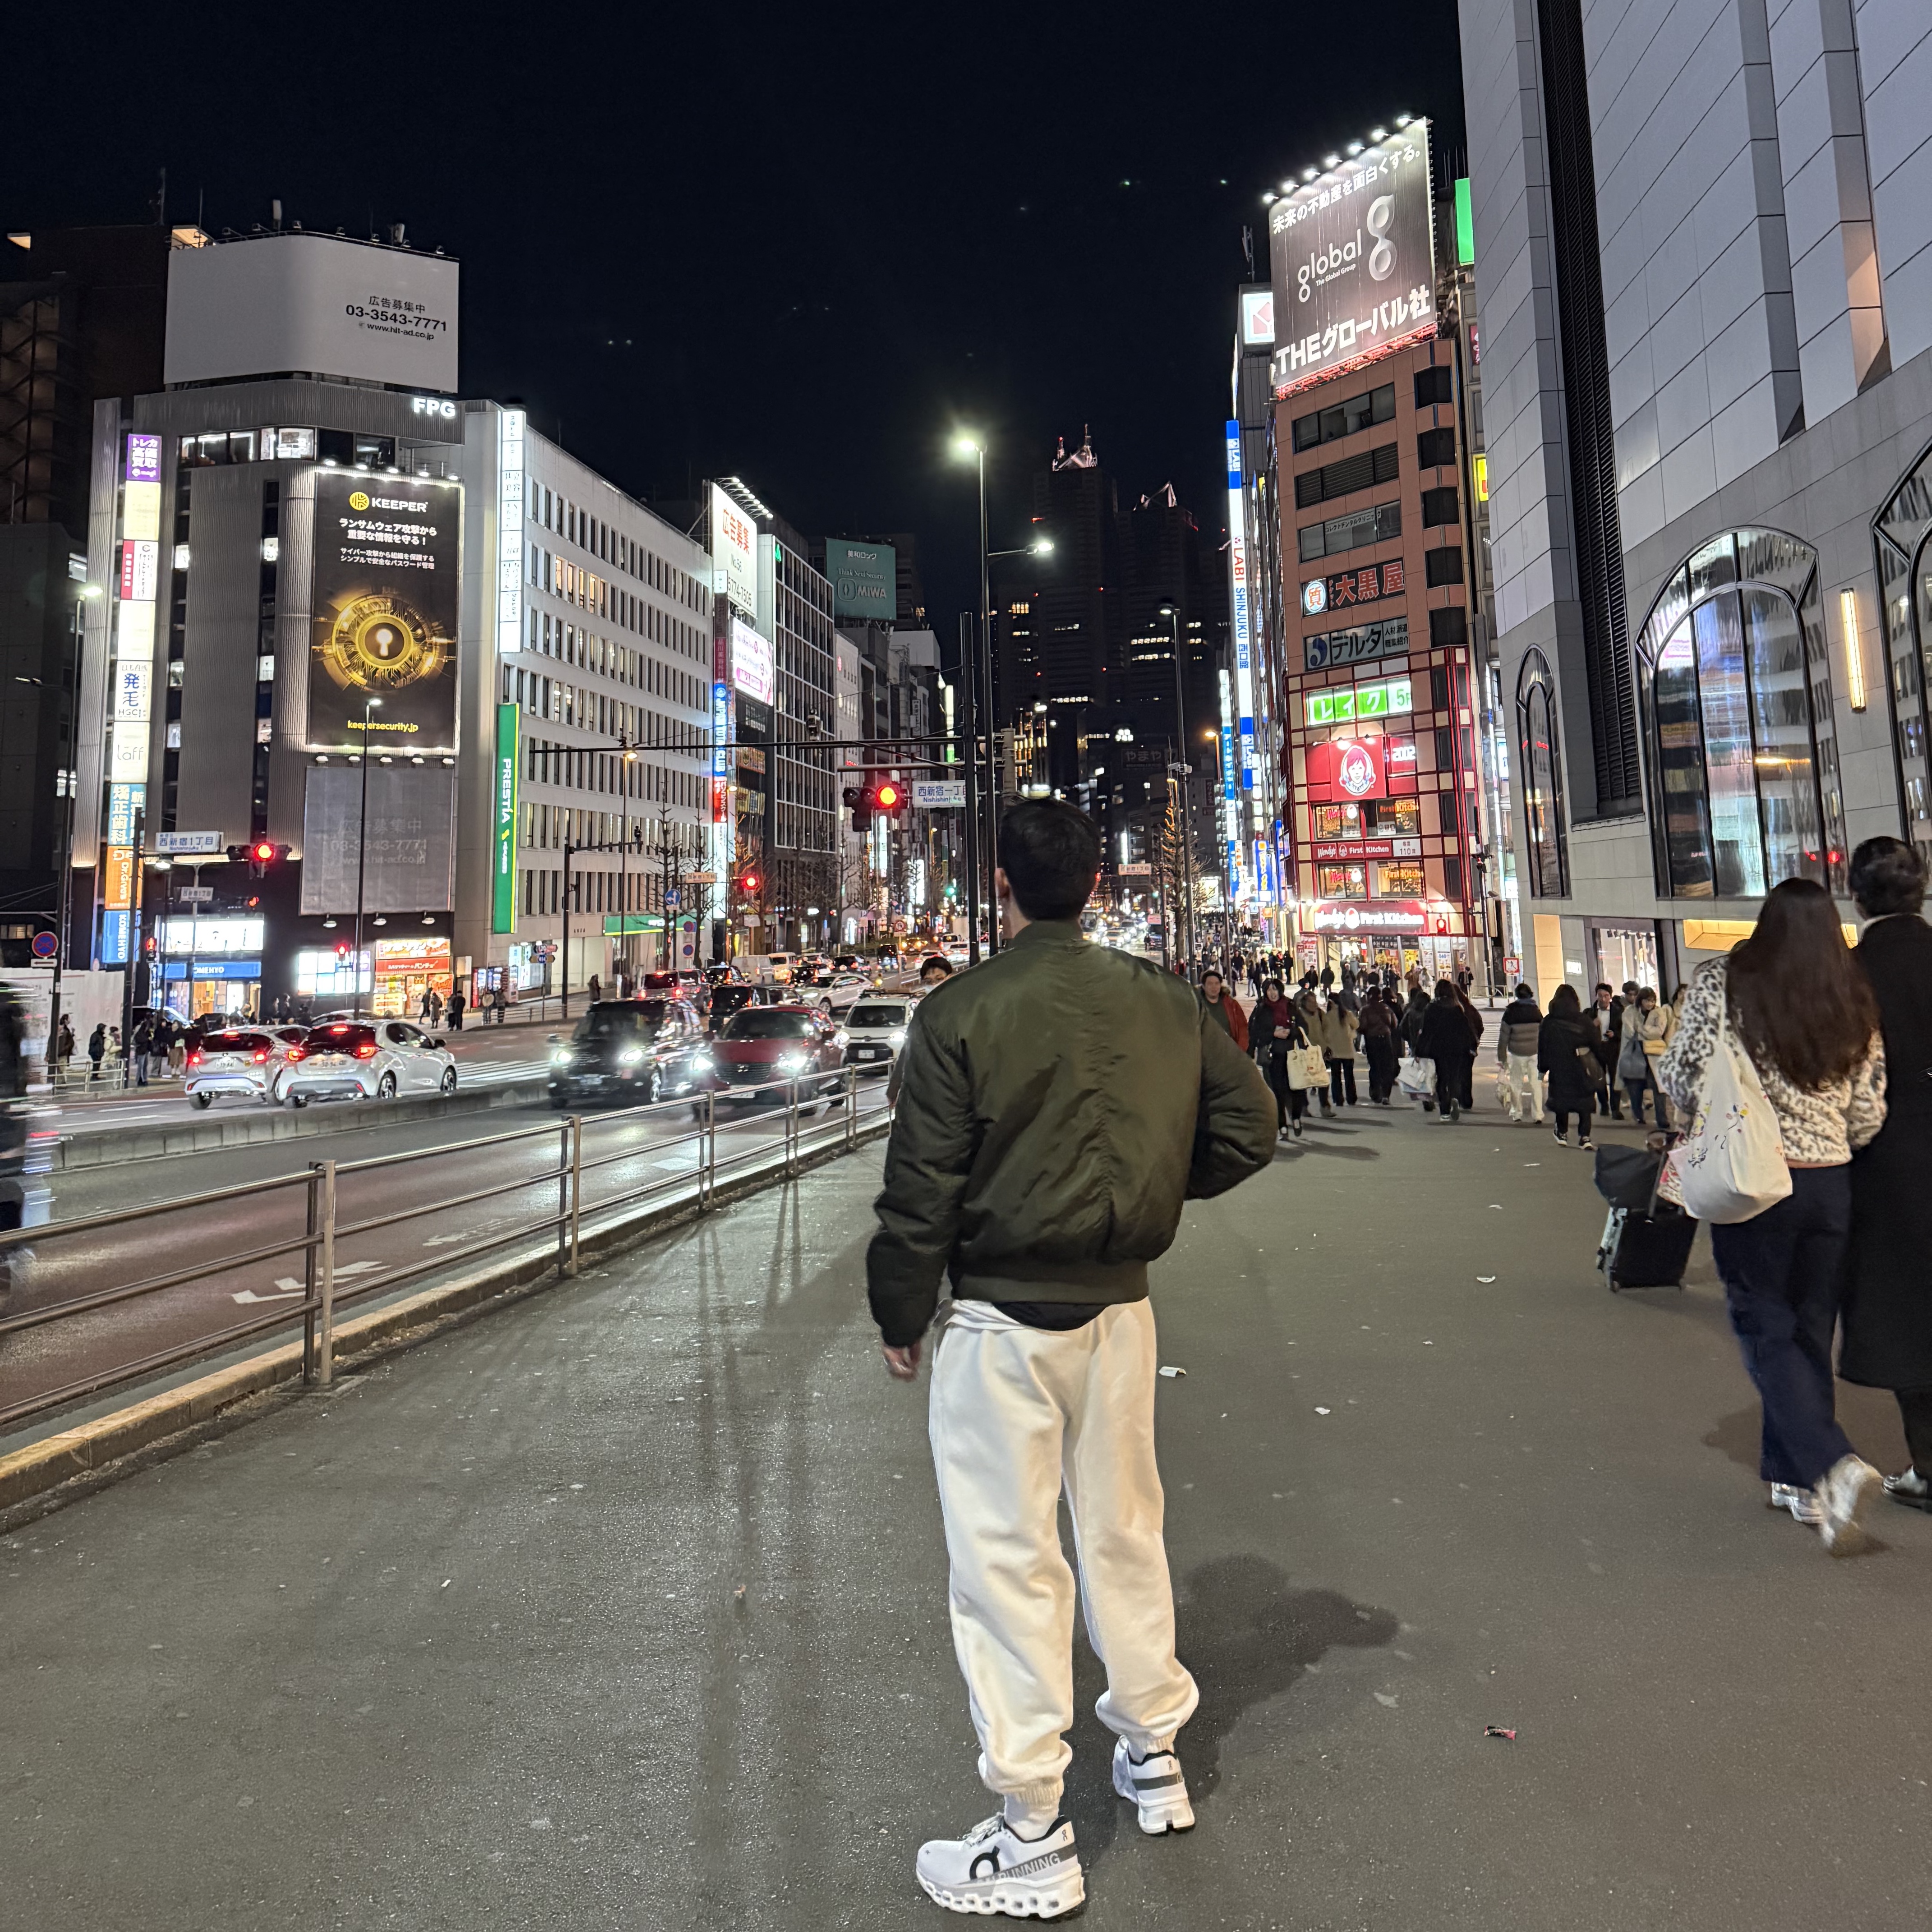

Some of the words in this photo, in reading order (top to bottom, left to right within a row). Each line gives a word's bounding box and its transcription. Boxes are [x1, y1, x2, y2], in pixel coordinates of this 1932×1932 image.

[1273, 144, 1420, 234] 未来の不動産を面白くする。
[1298, 229, 1361, 303] global
[1316, 278, 1324, 286] The
[1325, 269, 1340, 282] Global
[1341, 263, 1356, 275] Group
[369, 296, 425, 313] 広告募集中
[346, 305, 446, 331] 03-3543-7771
[1276, 284, 1430, 375] THEグローバル社
[367, 323, 434, 340] www.hit-ad.co.jp
[413, 398, 455, 417] FPG
[133, 437, 157, 447] トレカ
[372, 498, 427, 513] KEEPER
[339, 518, 437, 536] ランサムウェア攻撃から
[848, 550, 877, 560] 美和ロック
[1234, 547, 1245, 580] LABI
[839, 568, 853, 576] Think
[867, 573, 885, 581] Security
[1336, 561, 1405, 606] 大黒屋
[858, 586, 887, 599] MIWA
[1309, 585, 1323, 608] 質
[1236, 587, 1249, 639] SHINJUKU
[1239, 643, 1249, 669] 西口館
[1332, 628, 1382, 661] デルタ
[123, 673, 139, 707] 発毛
[1320, 691, 1380, 720] レイク
[111, 785, 129, 844] 矯正歯科
[1317, 846, 1336, 858] Wendy's
[117, 914, 127, 960] KOMEHYO
